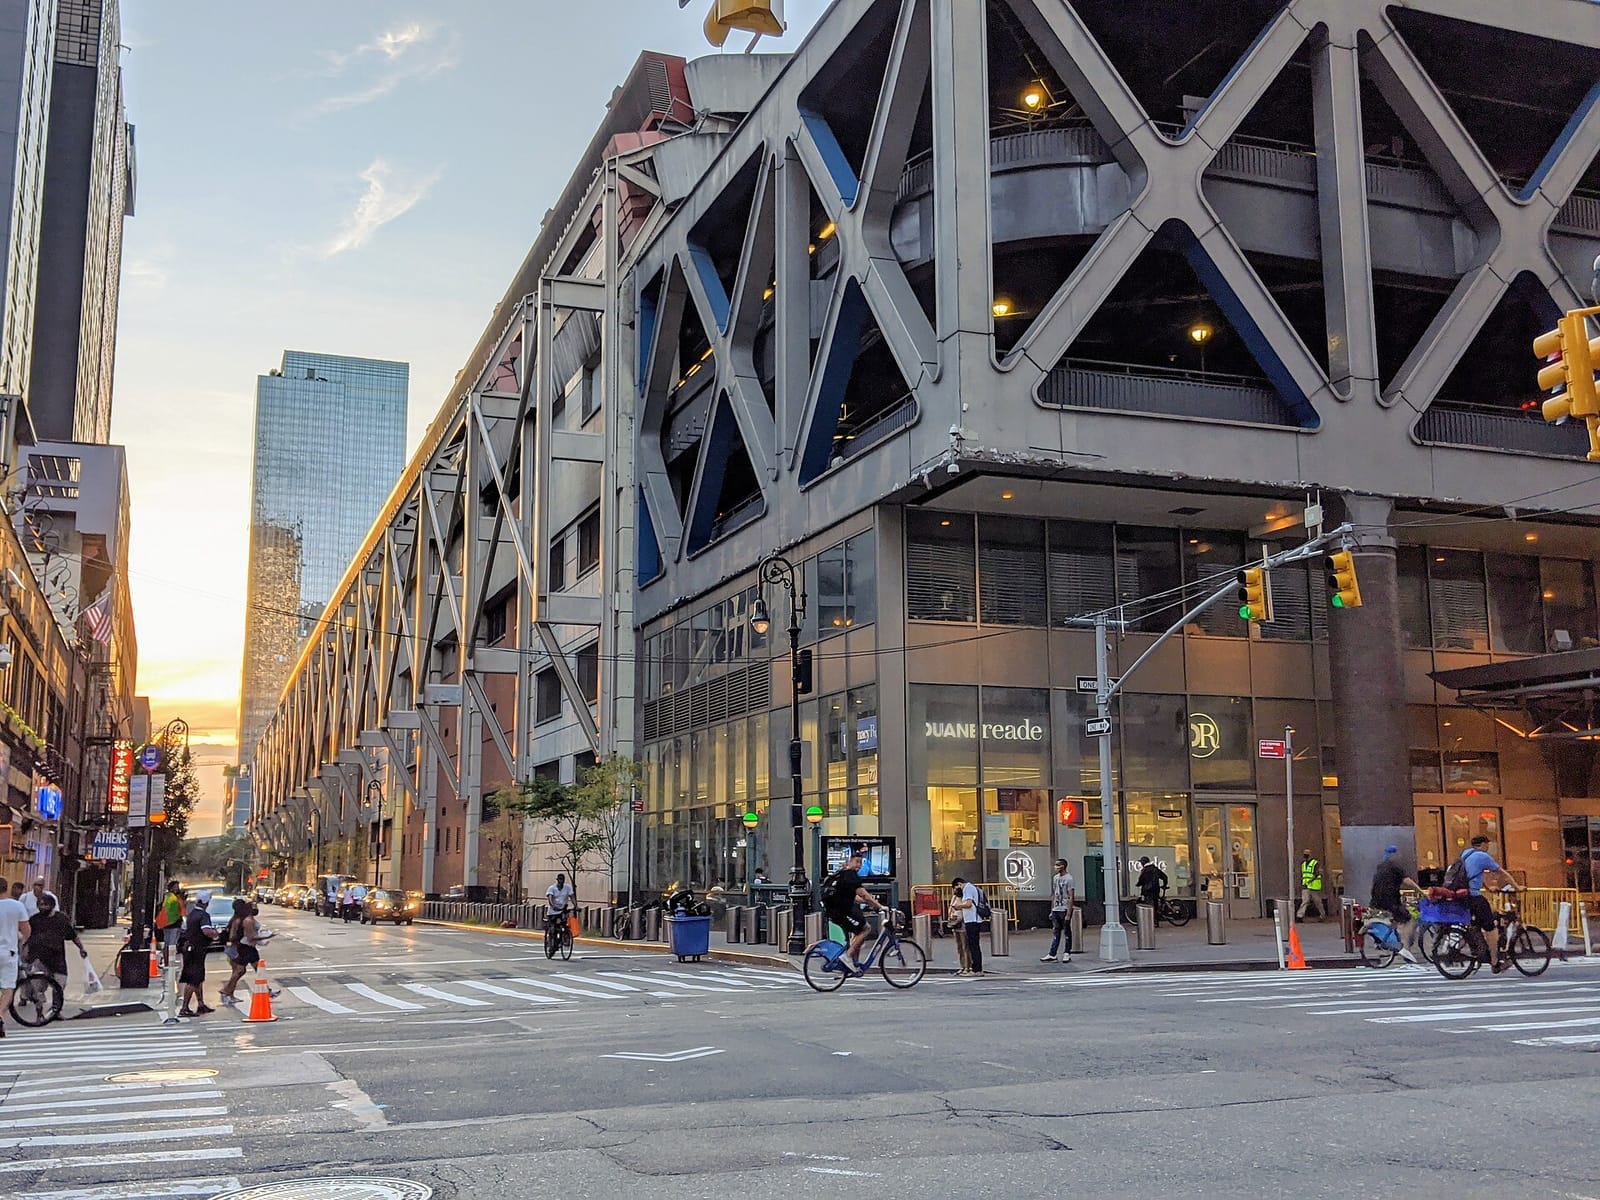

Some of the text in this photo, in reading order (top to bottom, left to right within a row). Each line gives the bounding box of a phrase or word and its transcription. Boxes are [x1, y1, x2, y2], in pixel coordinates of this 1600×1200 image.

[925, 719, 1042, 740] DUANE reade
[94, 832, 128, 844] ATHENS
[92, 846, 128, 860] LIQUORS
